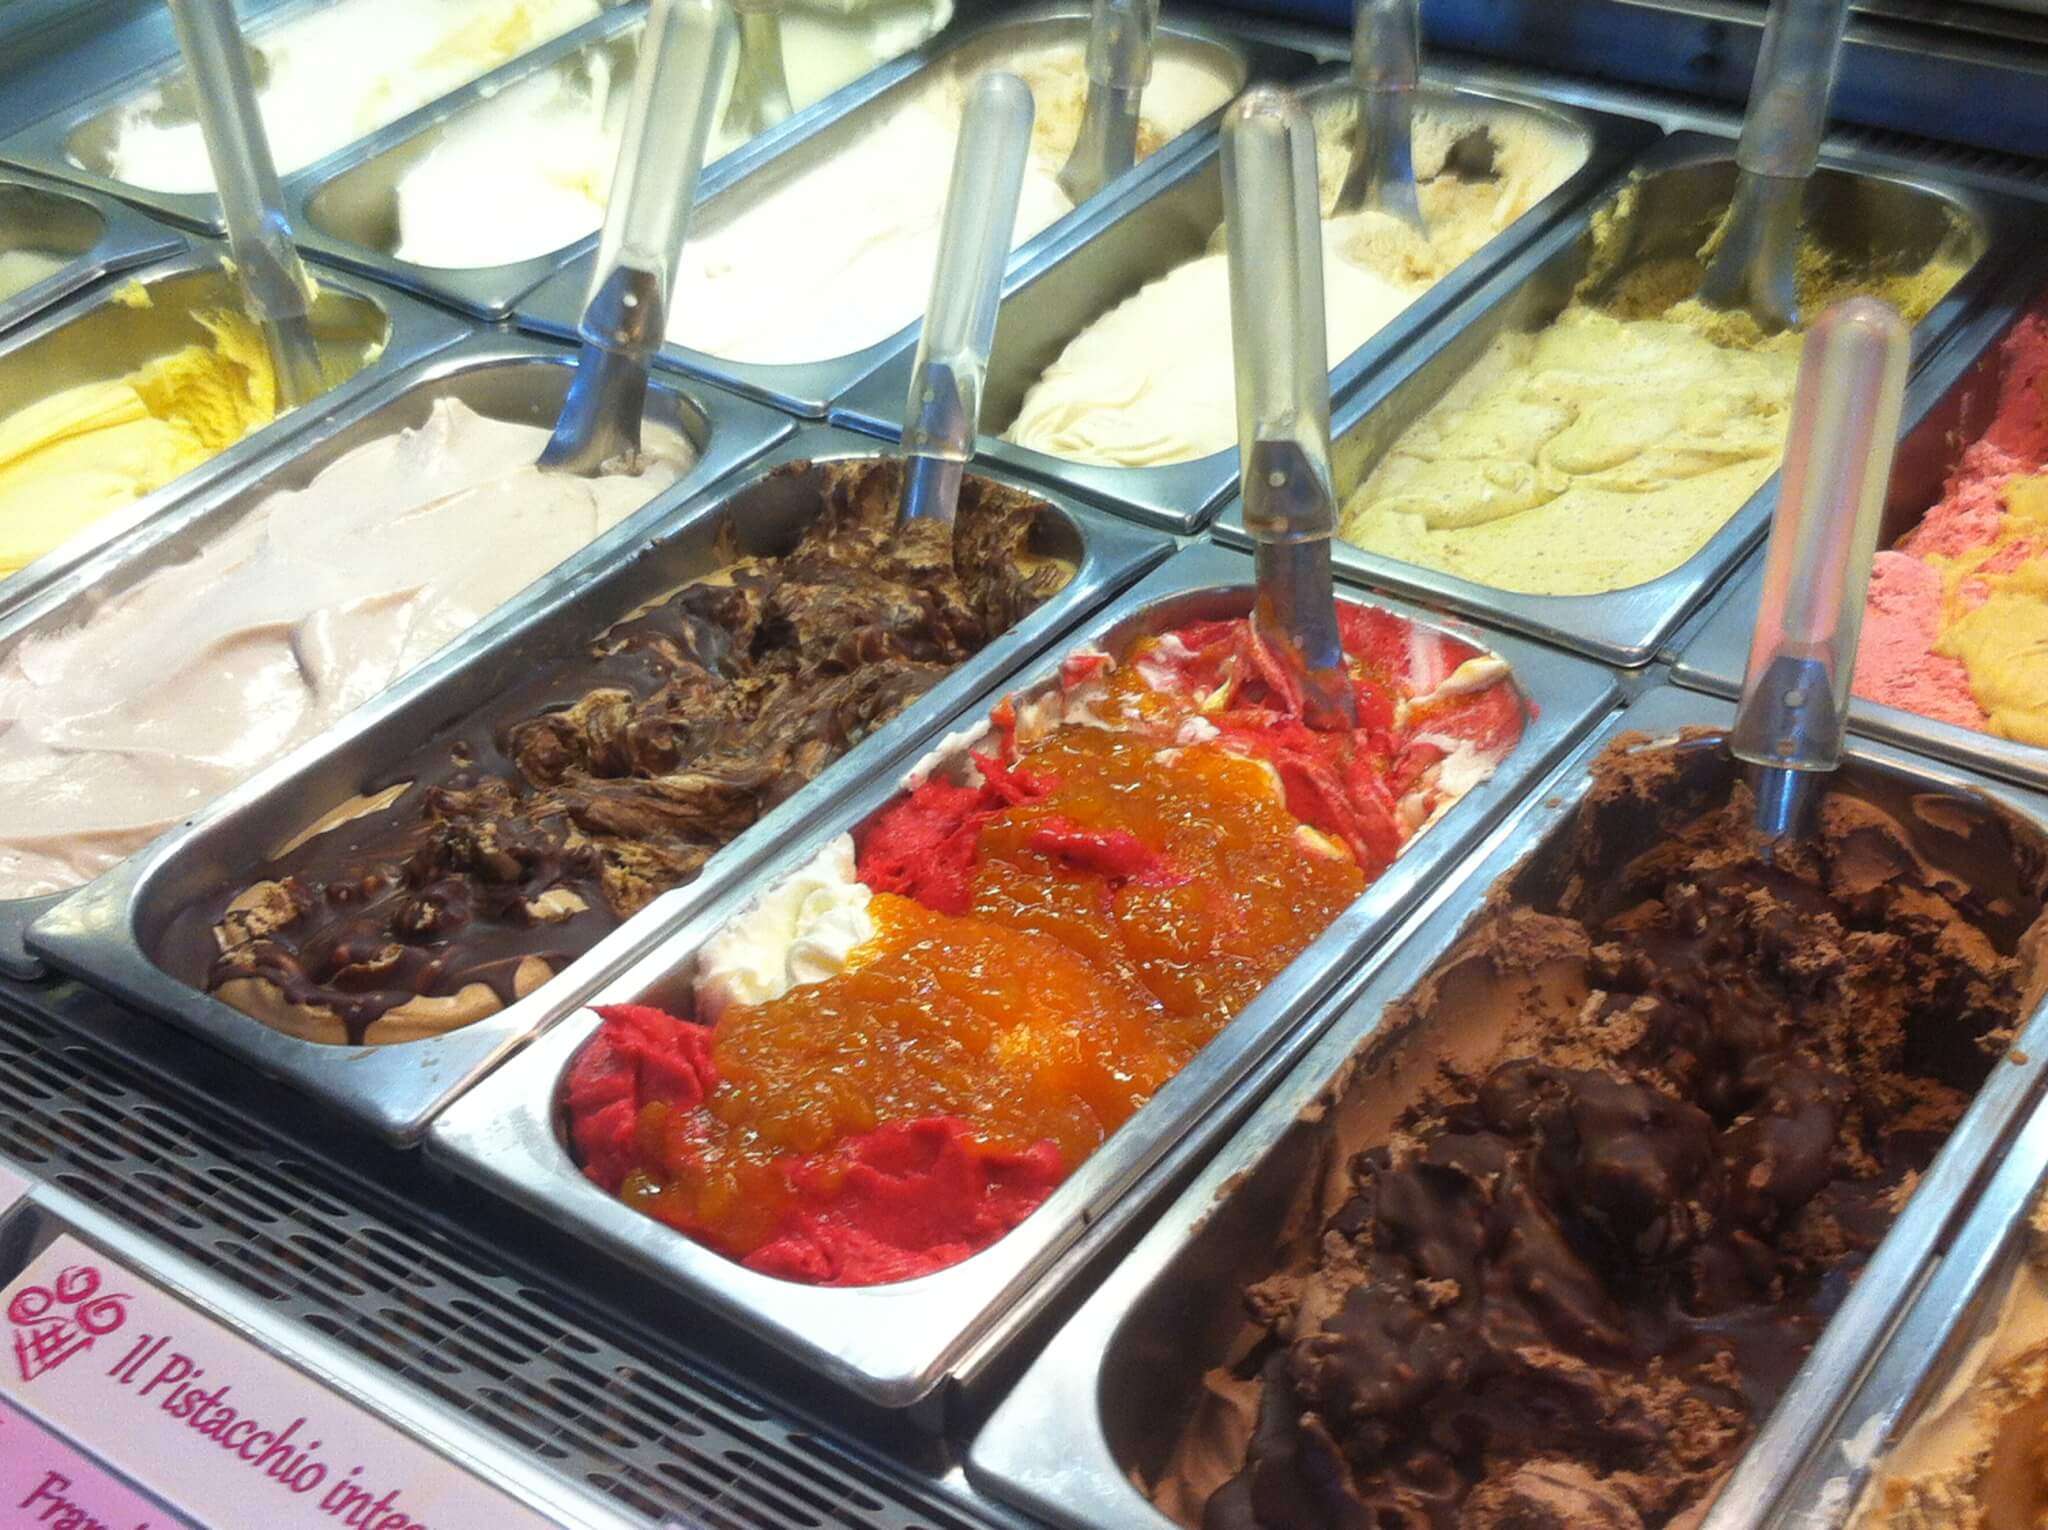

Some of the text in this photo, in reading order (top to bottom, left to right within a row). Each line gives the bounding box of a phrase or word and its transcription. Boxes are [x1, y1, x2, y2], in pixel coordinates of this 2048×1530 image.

[106, 1334, 427, 1530] Il Pistacchio inte
